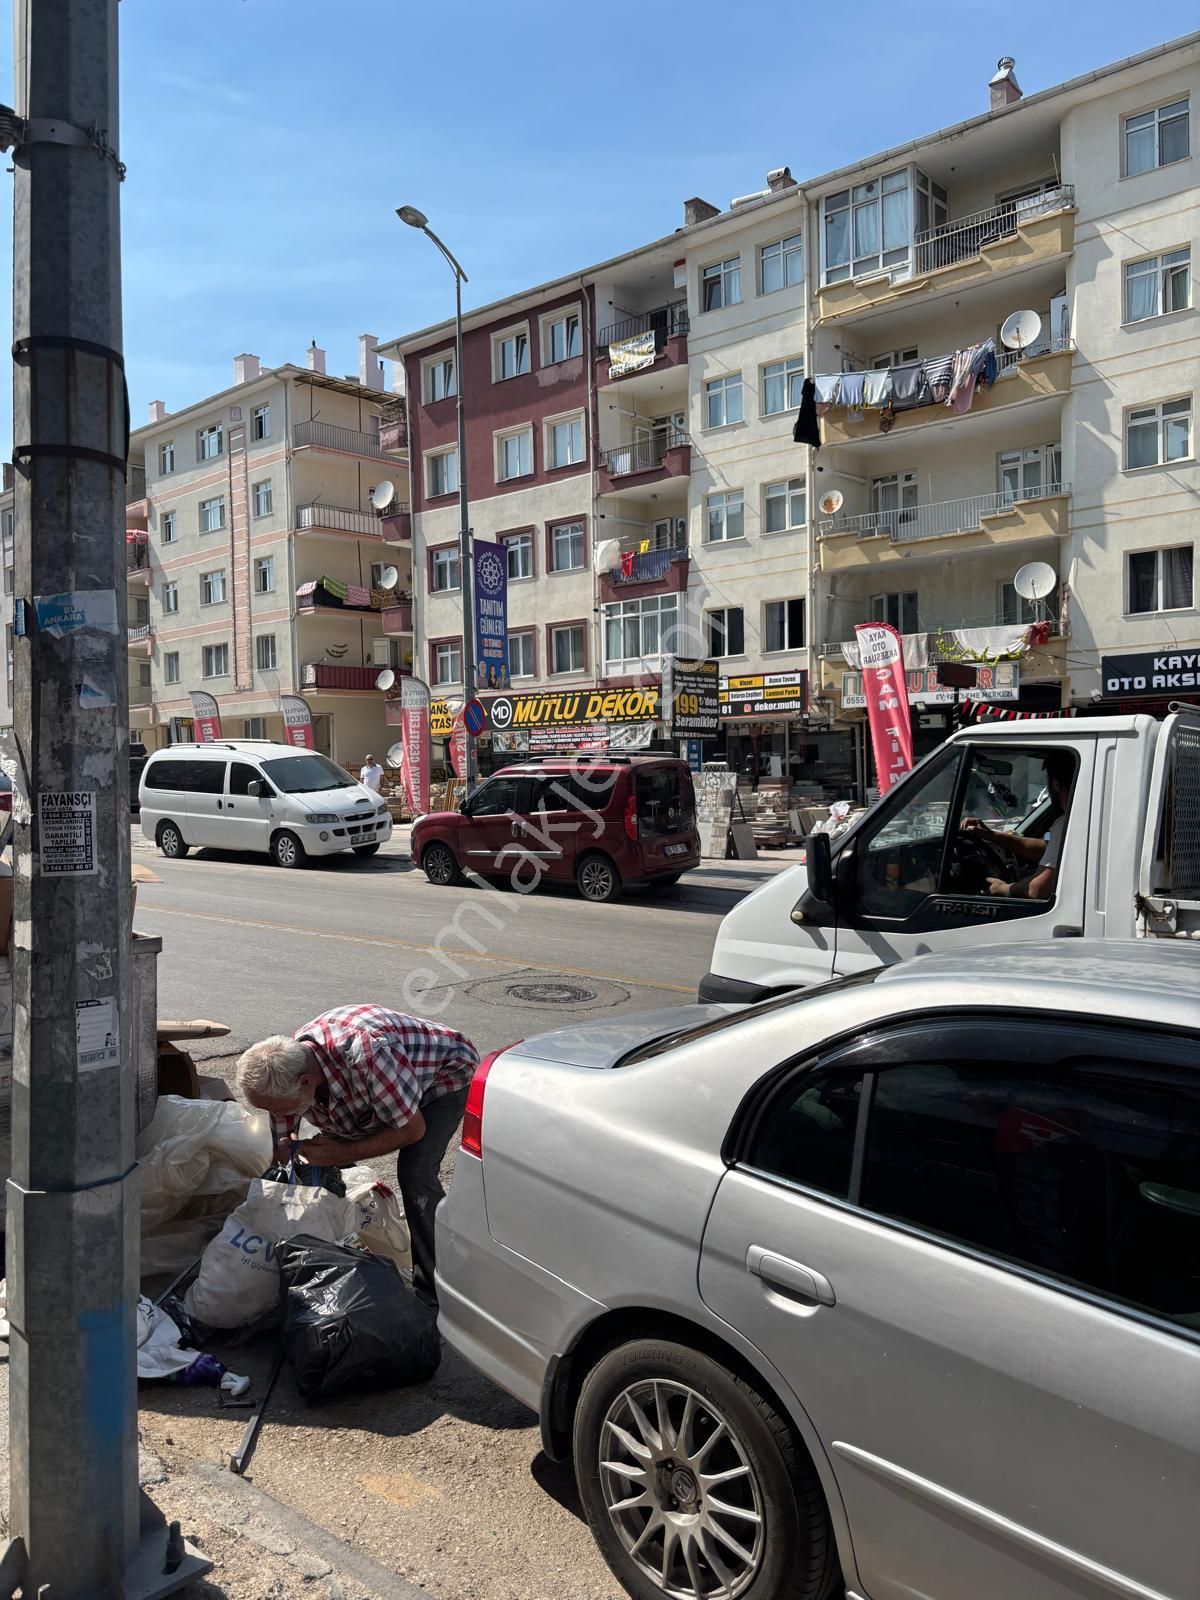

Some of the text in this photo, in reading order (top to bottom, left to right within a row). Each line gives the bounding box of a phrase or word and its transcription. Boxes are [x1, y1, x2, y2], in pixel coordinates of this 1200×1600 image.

[480, 598, 504, 617] TANITIM
[44, 613, 82, 625] ANKARA
[480, 616, 504, 637] GÜNLERİ
[1154, 655, 1200, 671] KAY
[1107, 676, 1146, 691] OTO
[492, 705, 510, 719] MD
[513, 690, 659, 723] MUTLU DEKOR
[674, 694, 699, 715] 199
[754, 701, 801, 711] dekor.mutlu
[675, 714, 718, 729] Seramikler
[41, 793, 92, 808] FAYANSÇI
[936, 903, 1001, 917] TRANSIT
